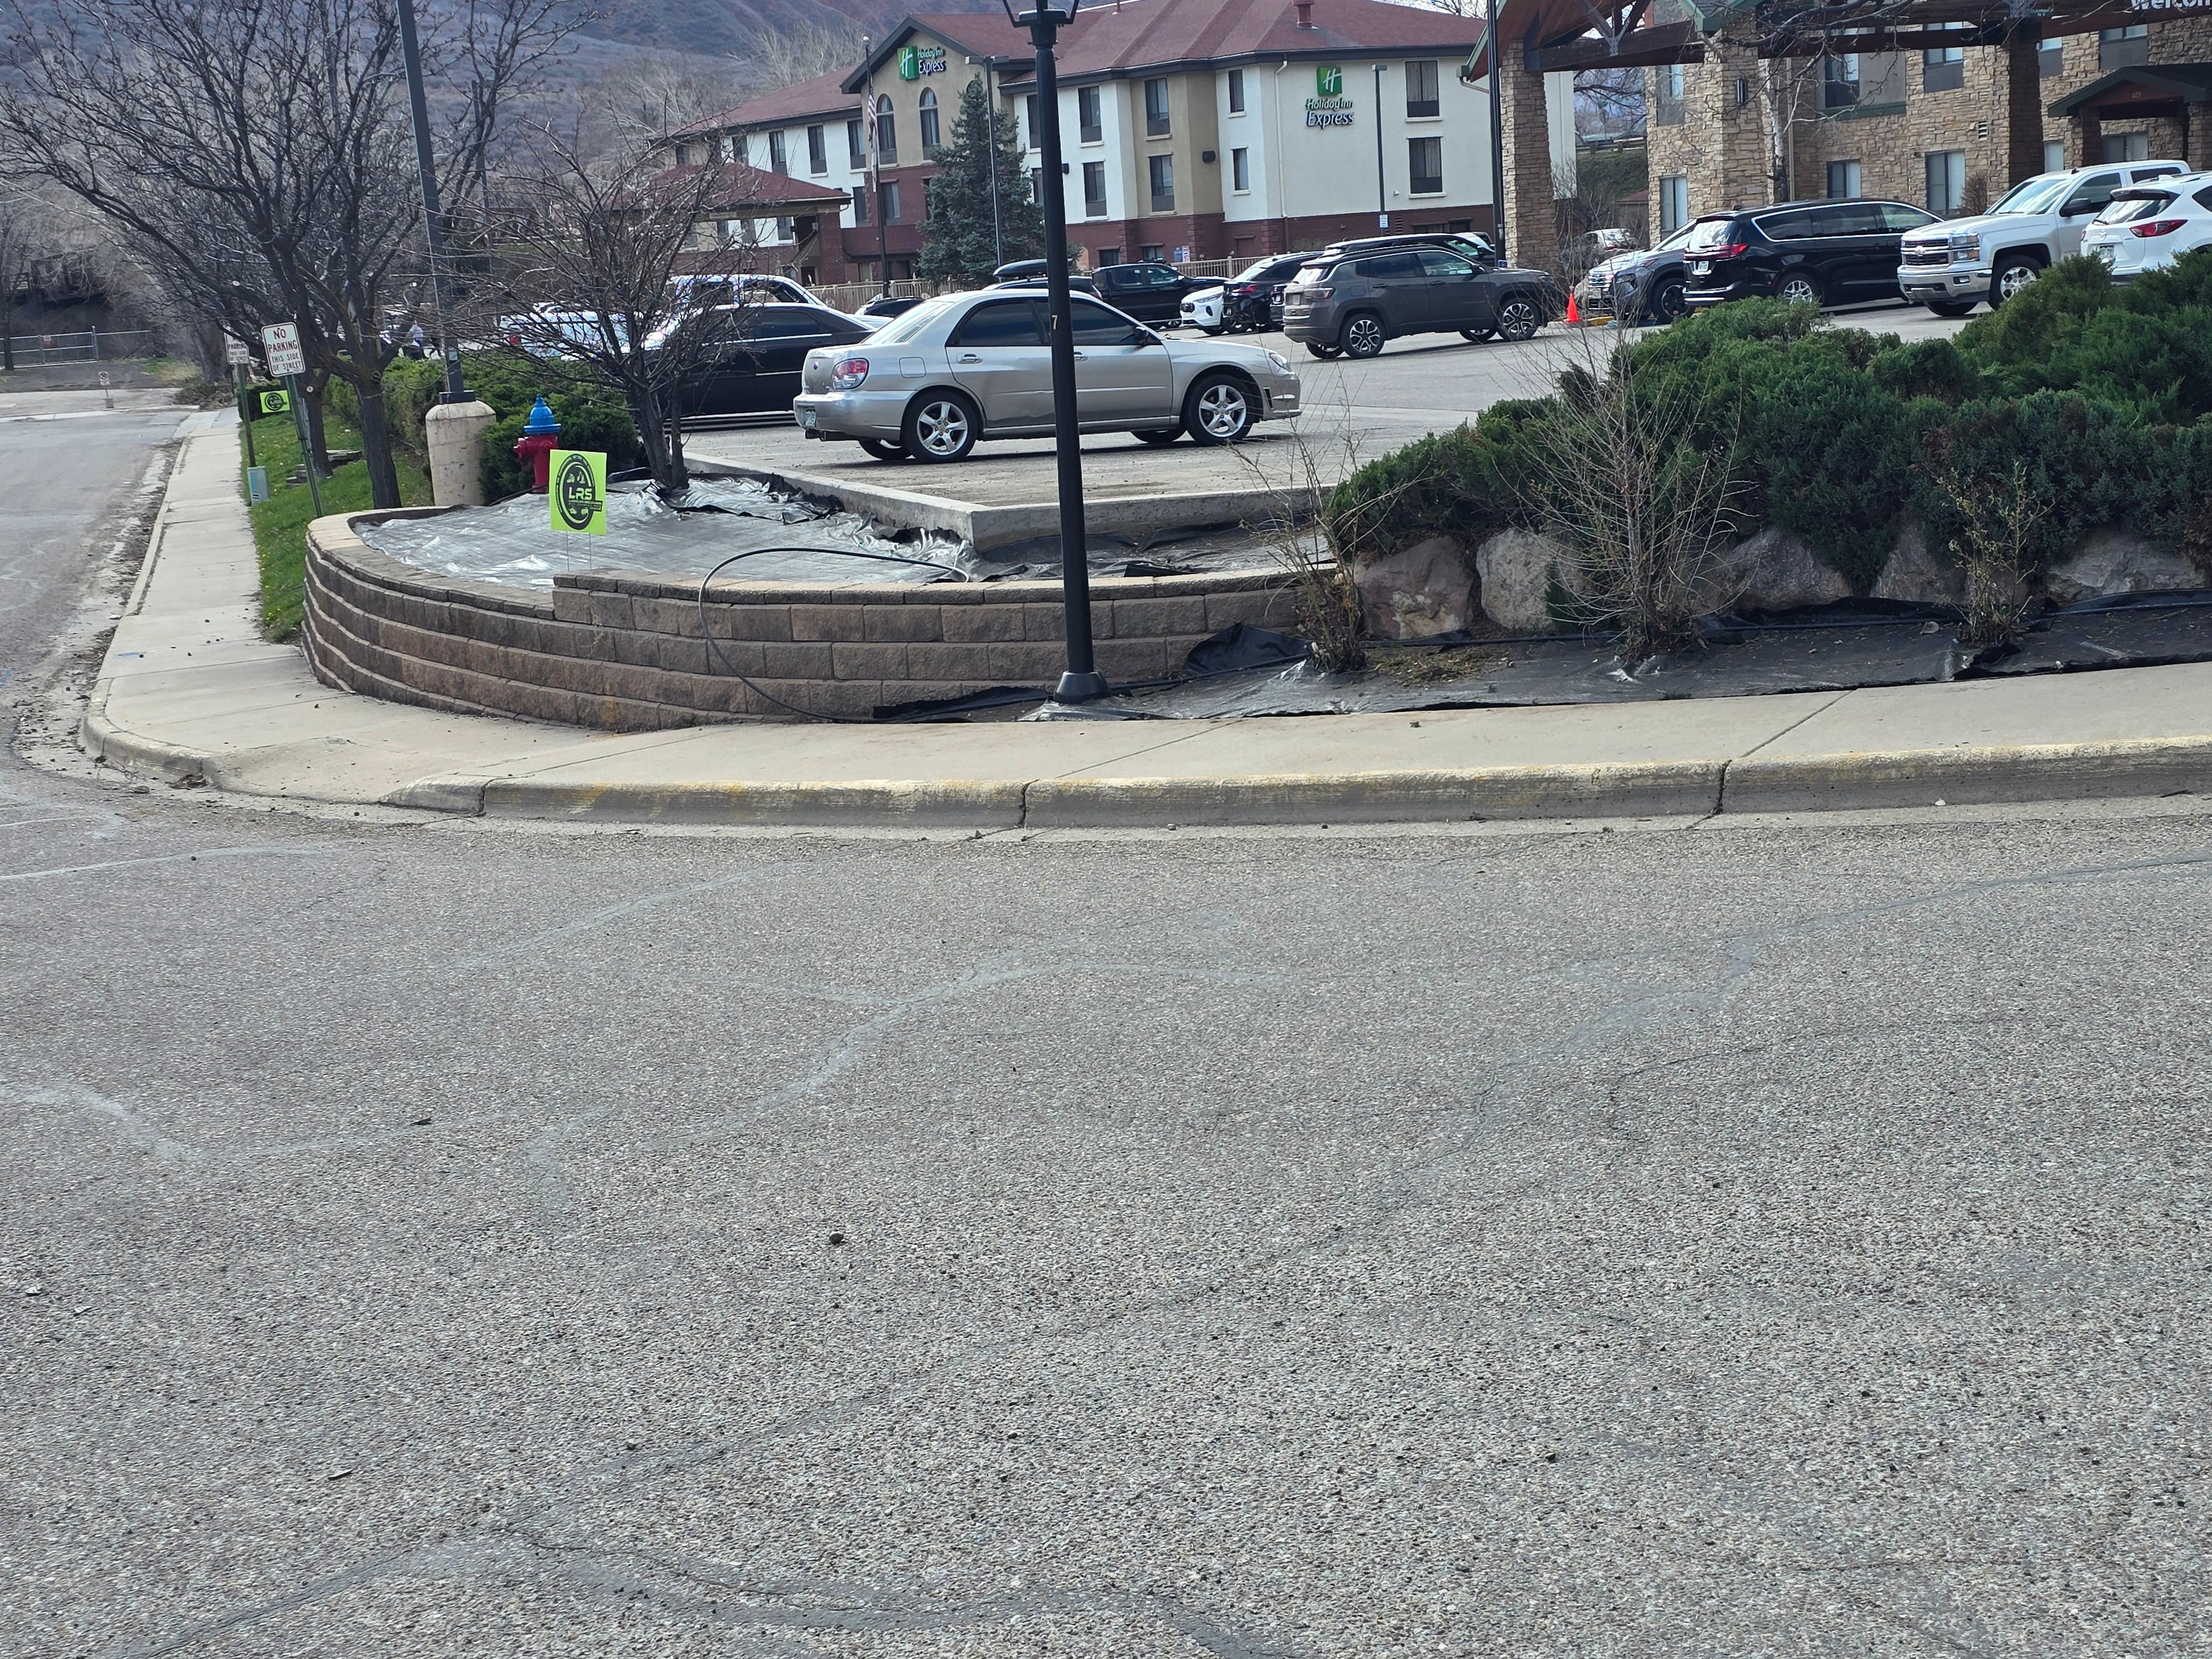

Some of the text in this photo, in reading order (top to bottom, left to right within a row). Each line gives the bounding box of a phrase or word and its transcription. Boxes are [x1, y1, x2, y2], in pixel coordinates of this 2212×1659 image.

[918, 48, 935, 59] Holiday
[919, 60, 944, 76] Express
[1307, 98, 1354, 111] Holiday Inn
[1307, 111, 1354, 129] Express
[1052, 315, 1058, 330] 7
[273, 328, 286, 340] NO
[268, 340, 298, 353] PARKING
[272, 354, 284, 363] THIS
[283, 361, 302, 371] STREET
[568, 487, 592, 500] LRS
